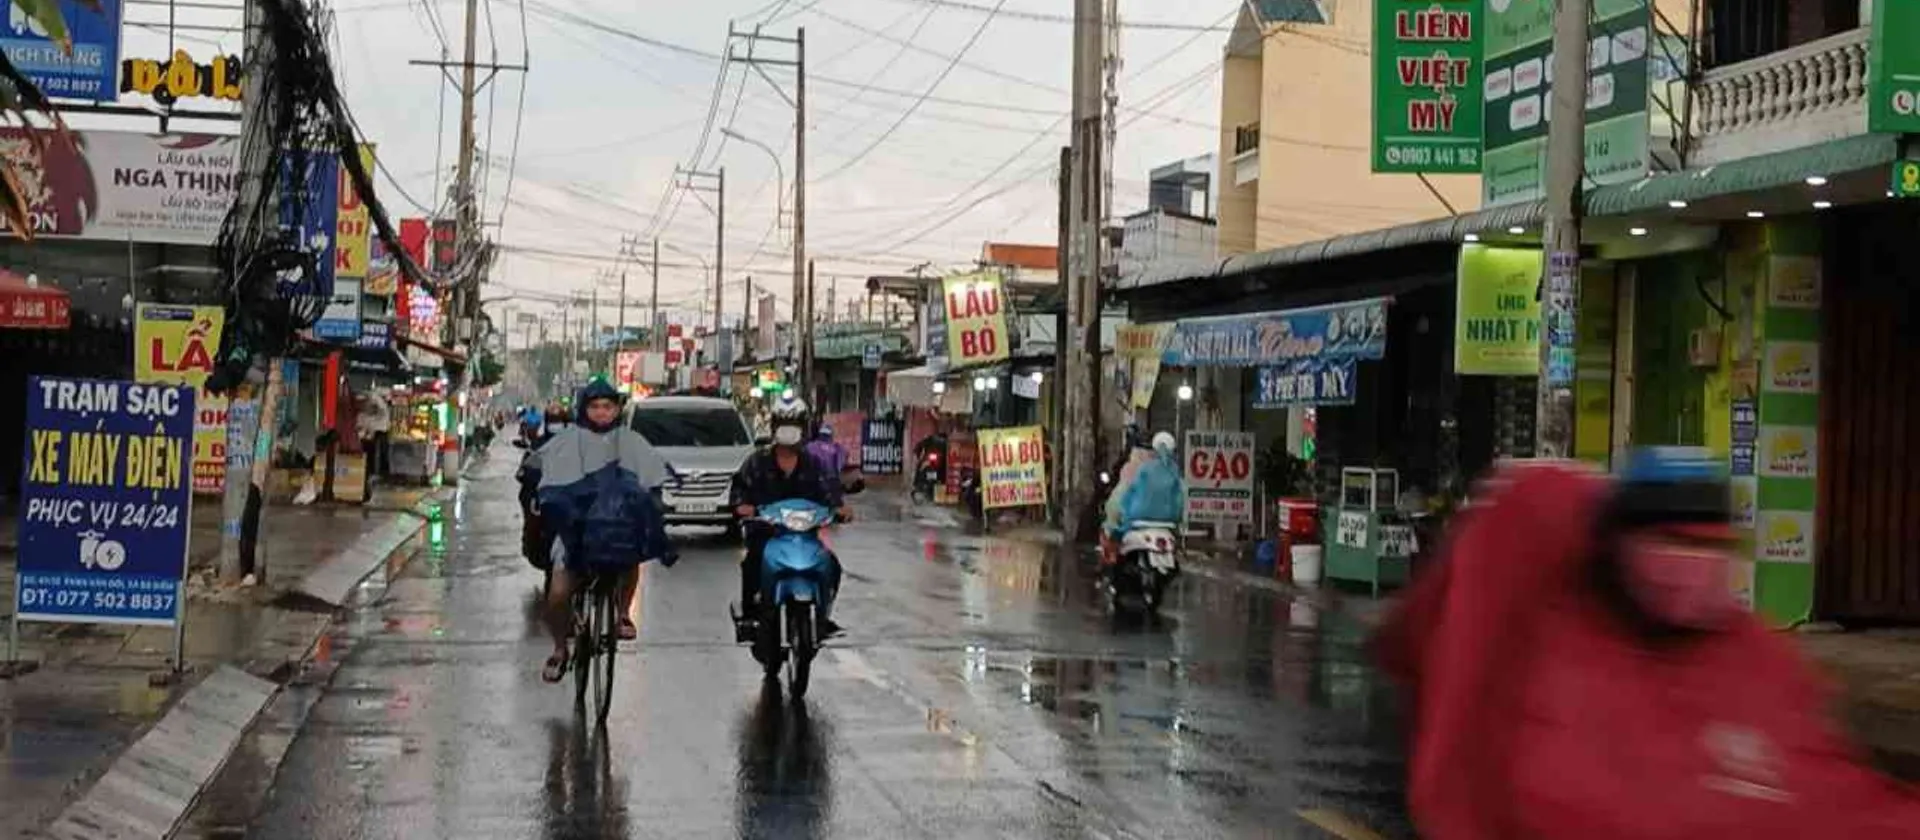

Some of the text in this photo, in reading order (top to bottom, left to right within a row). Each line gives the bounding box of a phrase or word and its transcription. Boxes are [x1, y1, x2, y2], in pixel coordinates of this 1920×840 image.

[1396, 4, 1471, 40] LIÊN
[1396, 51, 1471, 93] VIỆT
[1408, 93, 1457, 132] MỸ
[114, 168, 167, 188] NGA
[950, 283, 999, 320] LẨU
[960, 320, 997, 358] BÒ
[40, 380, 180, 422] TRẠM SẠC
[29, 429, 62, 483] XE
[67, 418, 121, 486] MÁY
[126, 421, 182, 502] ĐIỆN
[980, 431, 1014, 468] LẨU
[1189, 450, 1250, 489] GẠO
[27, 498, 179, 530] PHỤC VỤ 24/24
[22, 588, 174, 611] ĐT: 077 502 8837
